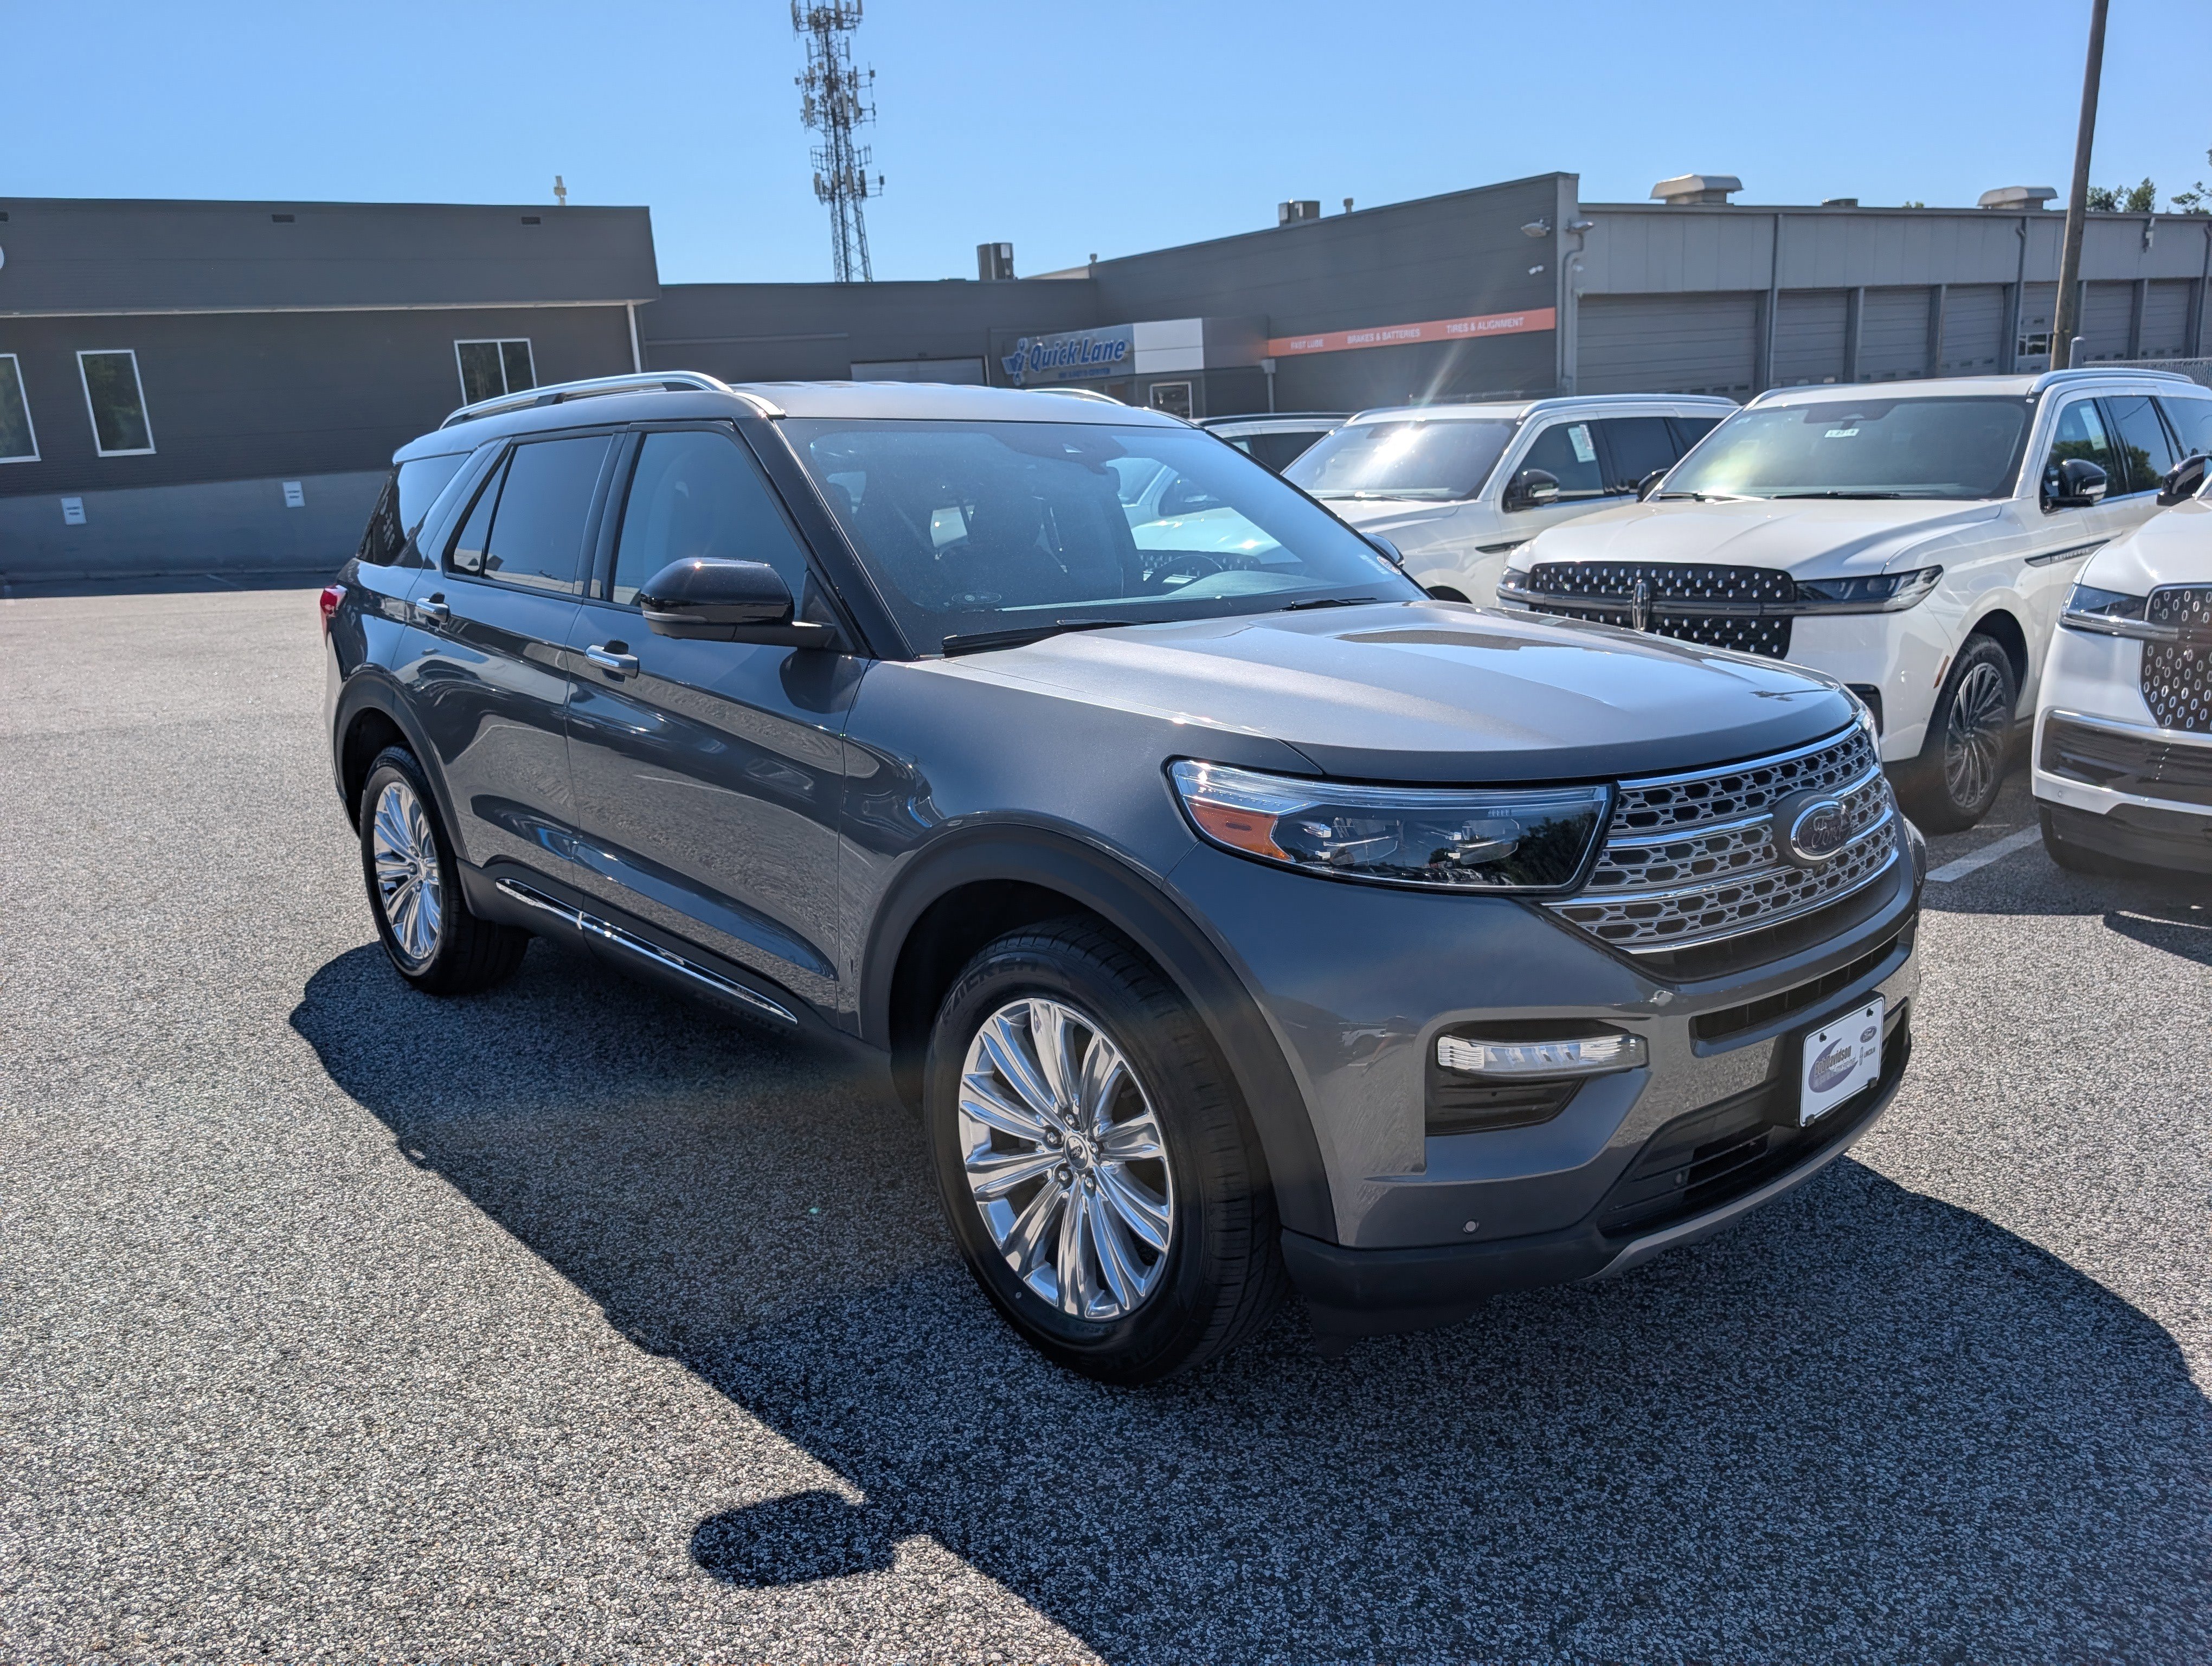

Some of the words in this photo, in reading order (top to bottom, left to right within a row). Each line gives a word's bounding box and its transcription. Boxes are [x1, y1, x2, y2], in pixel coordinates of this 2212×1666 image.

[1477, 317, 1524, 330] ALIGNMENT
[1382, 329, 1420, 340] BATTERIES
[1031, 340, 1080, 371] Quick
[1082, 338, 1127, 364] Lane
[1826, 1045, 1852, 1068] Davidson
